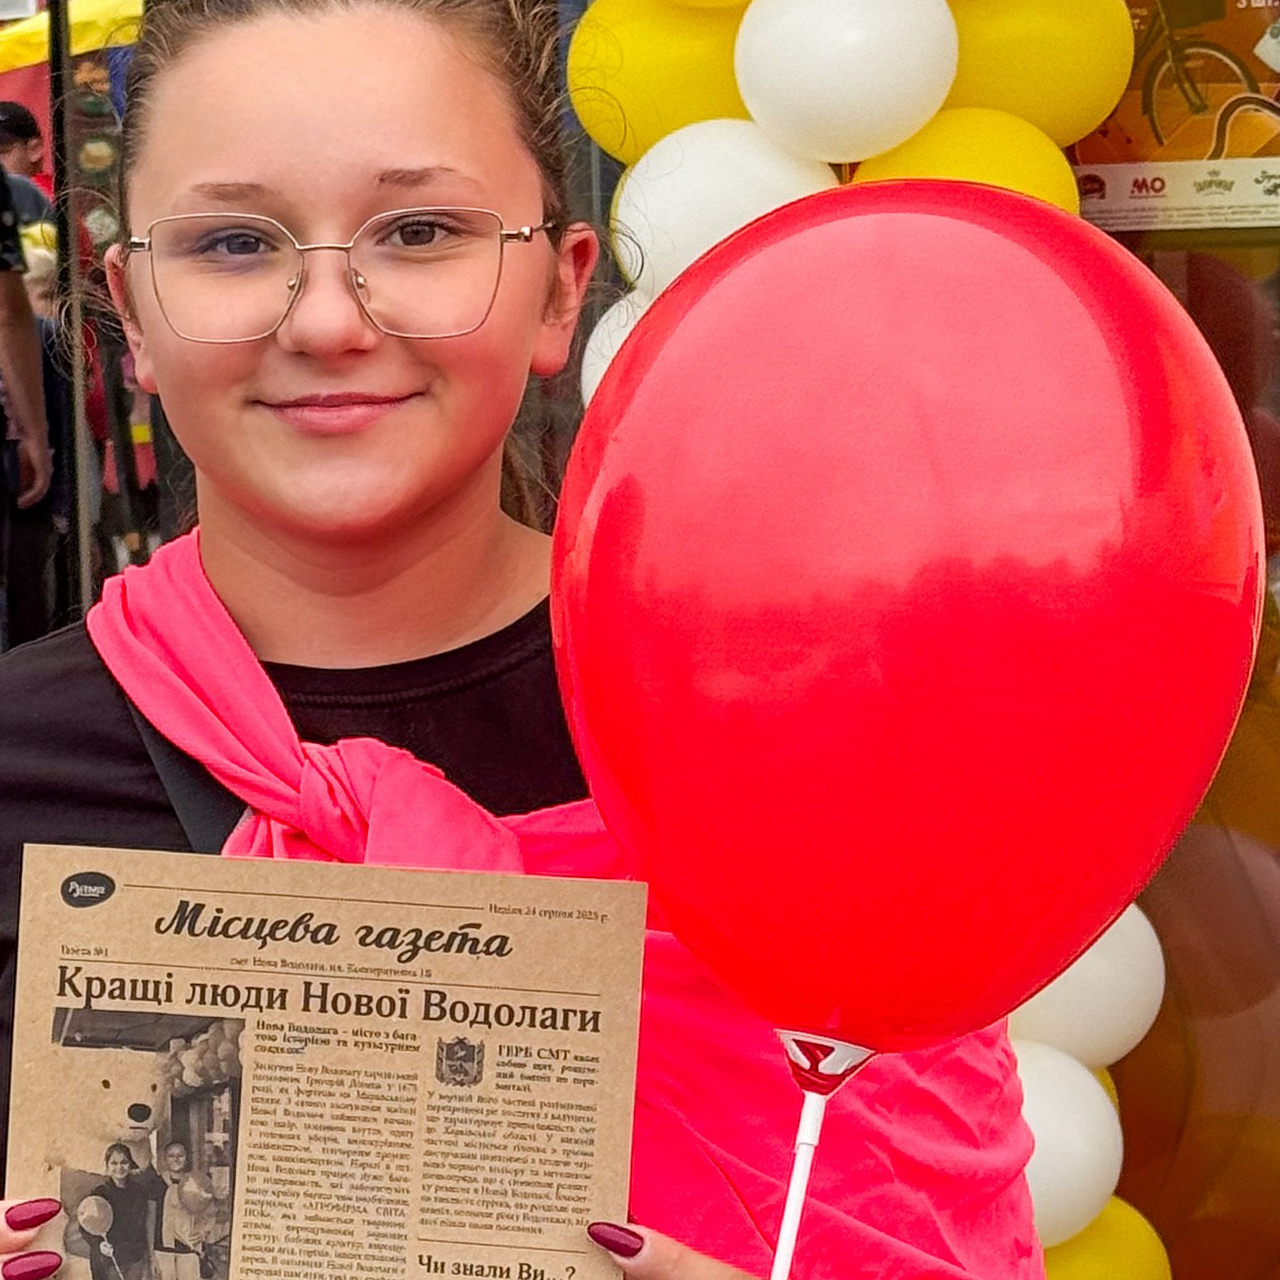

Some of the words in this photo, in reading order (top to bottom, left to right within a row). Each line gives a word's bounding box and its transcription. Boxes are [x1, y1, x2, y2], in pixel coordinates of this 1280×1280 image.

[155, 900, 340, 950] Місцева
[355, 923, 513, 964] газета
[56, 966, 173, 1016] Кращі
[185, 983, 288, 1013] люди
[302, 981, 410, 1019] Нової
[422, 990, 601, 1032] Водолаги
[537, 1048, 570, 1060] СМТ
[418, 1255, 445, 1273] Чи
[452, 1263, 510, 1279] знали
